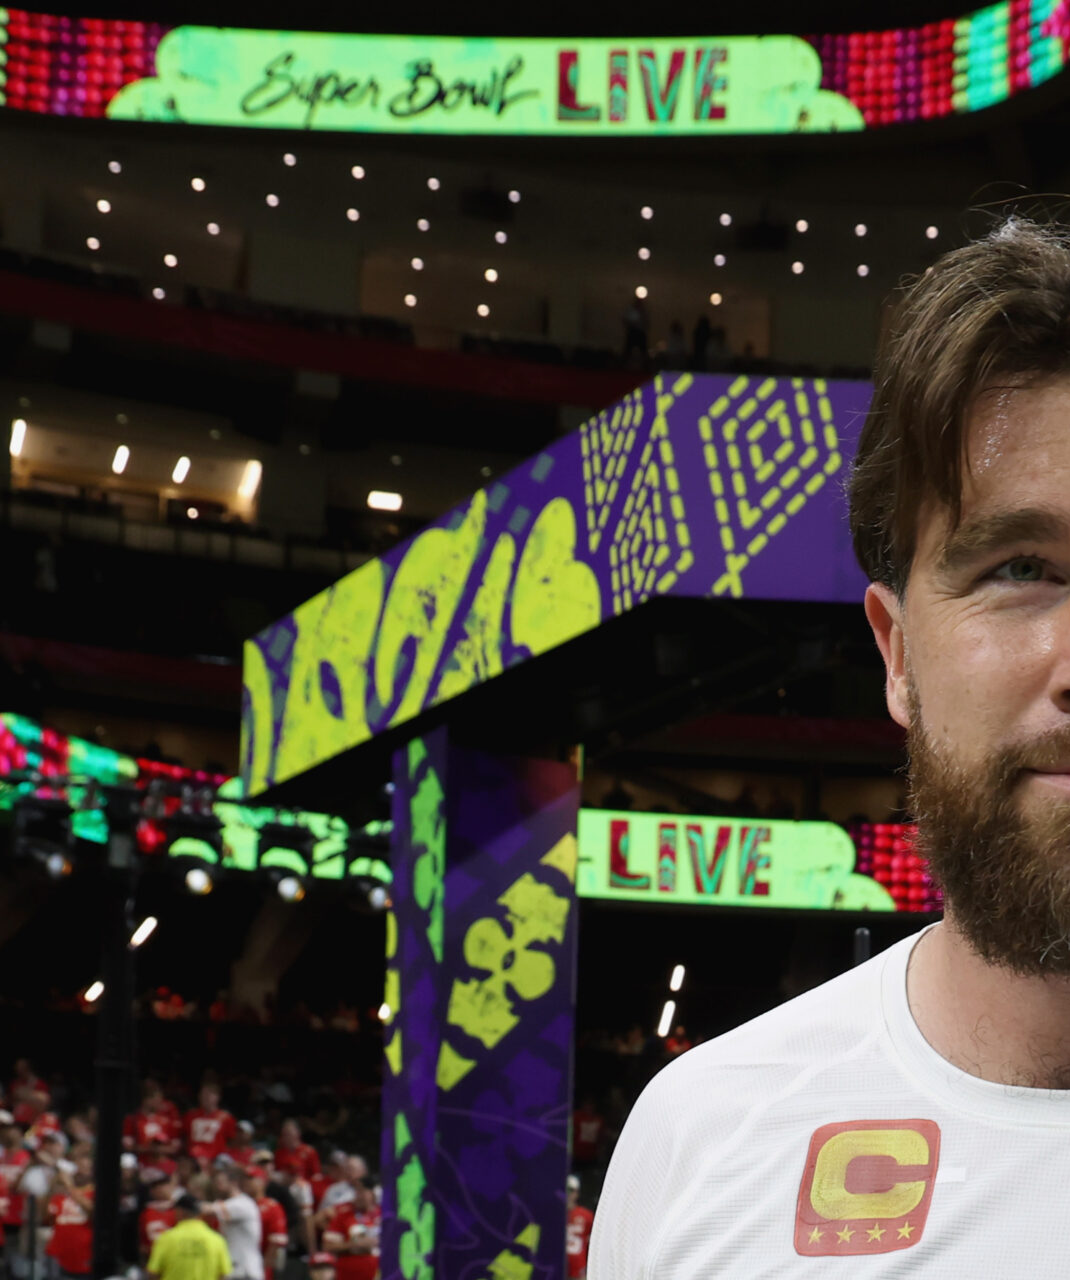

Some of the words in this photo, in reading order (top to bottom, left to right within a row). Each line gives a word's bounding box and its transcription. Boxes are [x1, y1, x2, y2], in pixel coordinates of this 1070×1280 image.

[241, 51, 382, 129] Super
[389, 56, 540, 118] Bowl
[557, 47, 729, 123] LIVE
[609, 819, 772, 896] LIVE
[809, 1129, 930, 1221] C
